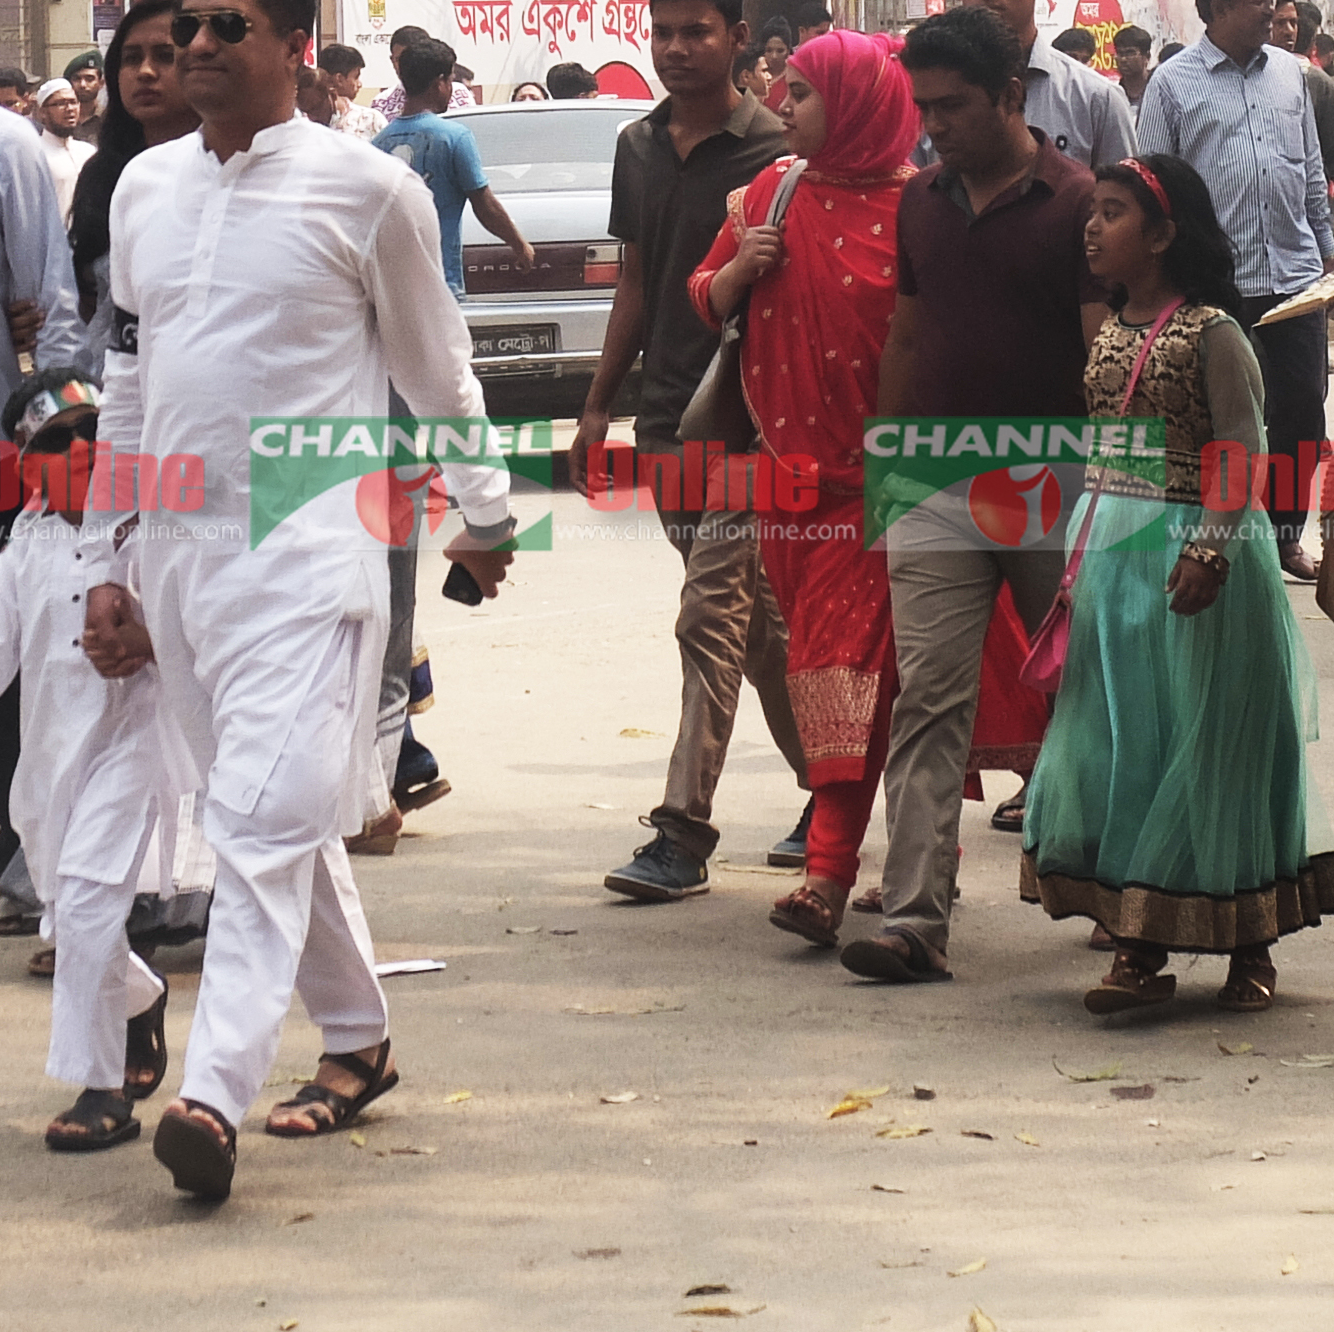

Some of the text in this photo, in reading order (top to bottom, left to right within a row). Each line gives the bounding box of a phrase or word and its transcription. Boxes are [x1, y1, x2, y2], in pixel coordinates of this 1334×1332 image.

[1080, 2, 1099, 17] অমর
[452, 0, 514, 45] অমর
[473, 338, 495, 353] াকা
